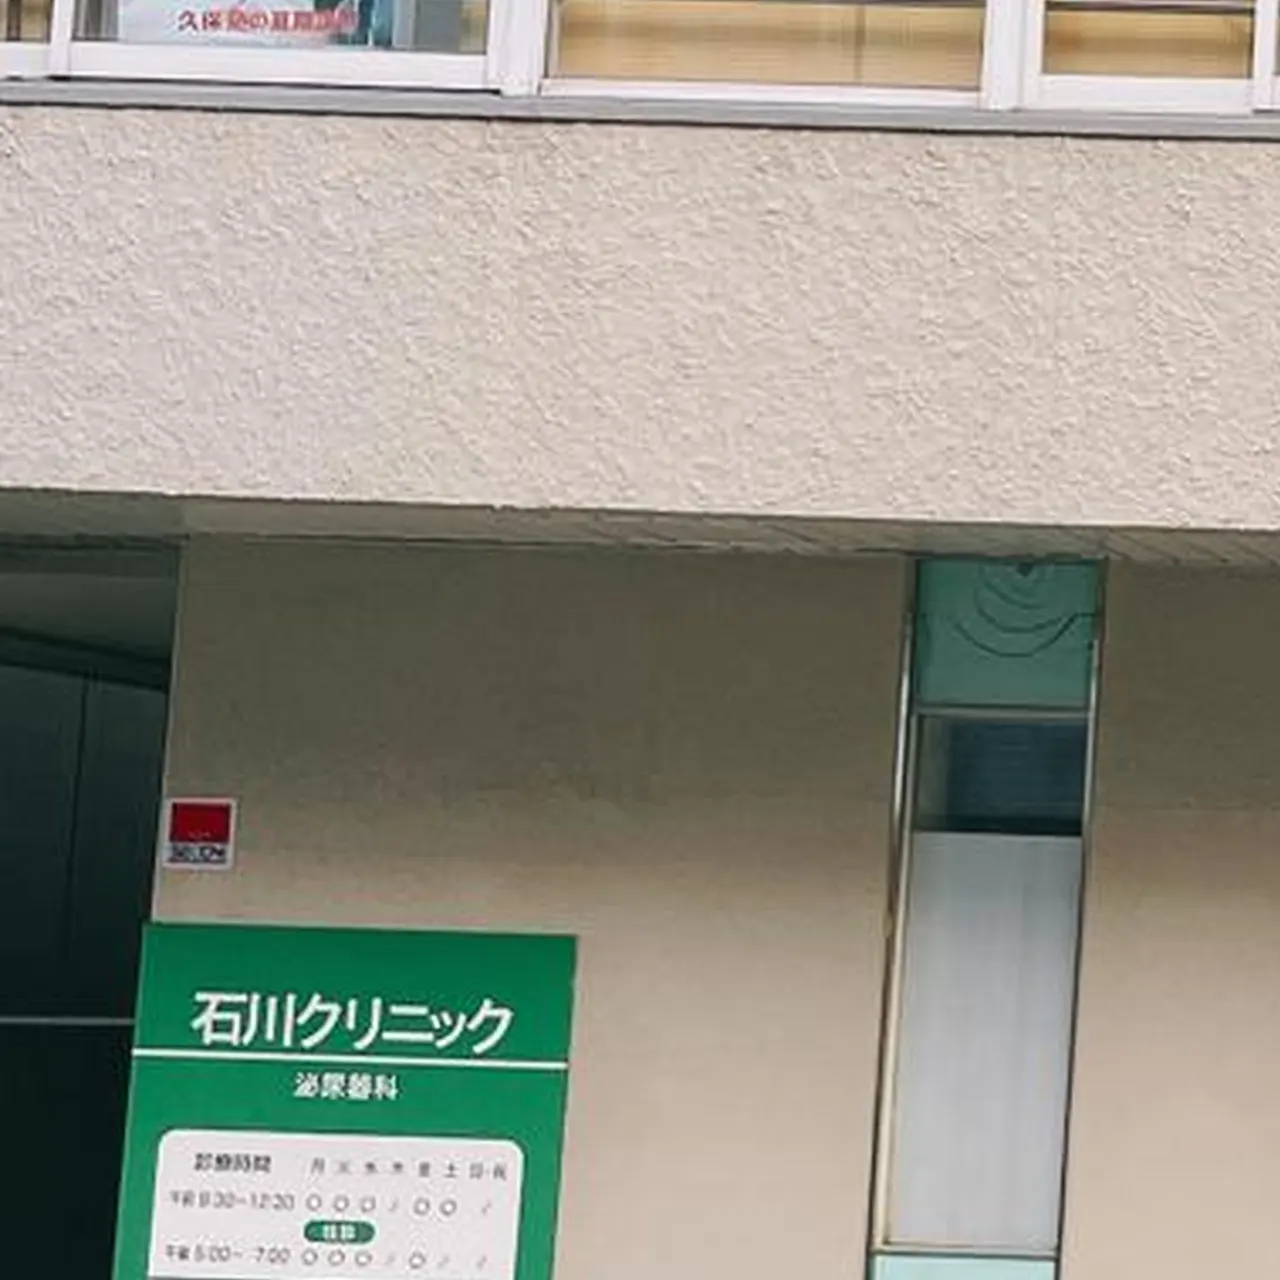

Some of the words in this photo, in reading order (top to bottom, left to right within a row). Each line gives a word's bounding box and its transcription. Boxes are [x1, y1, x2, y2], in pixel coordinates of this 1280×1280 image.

[190, 990, 515, 1054] 石川クリニック
[292, 1071, 401, 1102] 泌尿器科
